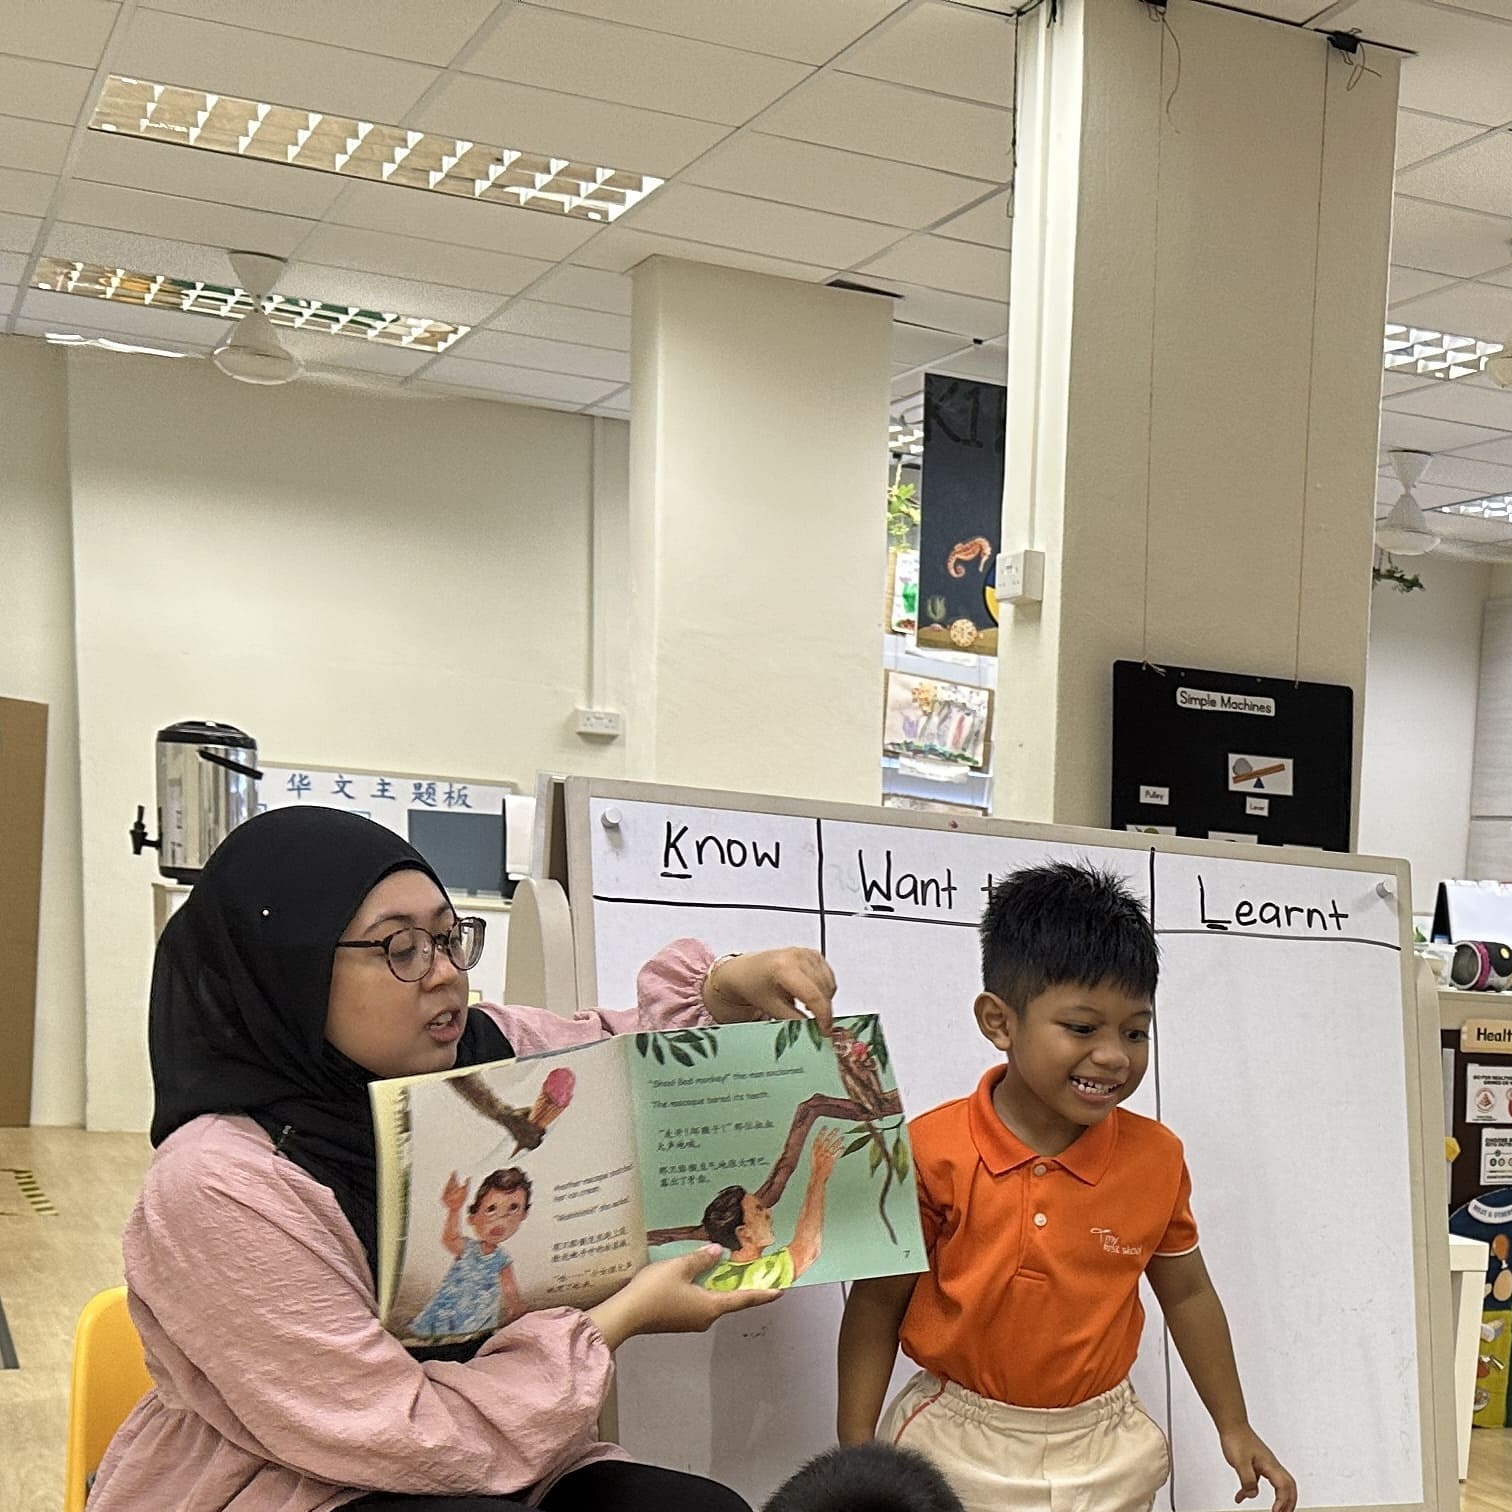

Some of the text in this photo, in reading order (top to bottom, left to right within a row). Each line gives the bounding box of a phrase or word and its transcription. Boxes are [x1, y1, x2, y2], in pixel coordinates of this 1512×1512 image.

[1179, 690, 1272, 714] Simple Machines
[287, 772, 473, 809] 华文主题板
[663, 820, 781, 871] Know
[858, 848, 957, 909] Want
[1197, 874, 1349, 931] Learnt
[903, 1249, 911, 1259] 7
